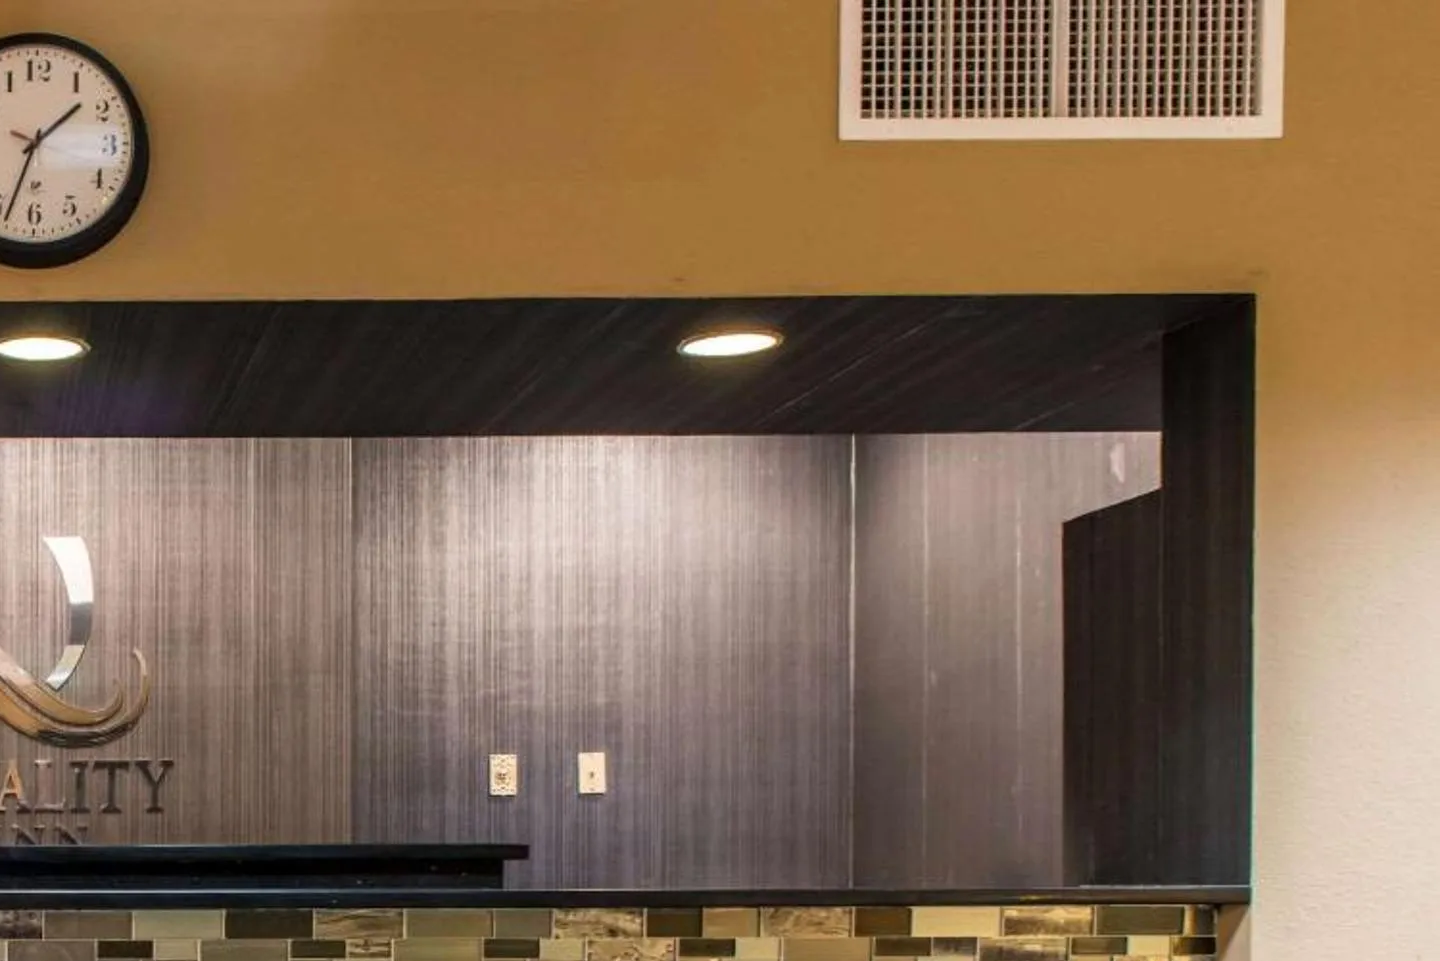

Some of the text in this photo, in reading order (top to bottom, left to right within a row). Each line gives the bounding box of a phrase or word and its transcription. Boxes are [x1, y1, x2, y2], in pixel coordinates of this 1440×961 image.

[26, 59, 51, 82] 12
[73, 71, 79, 93] 1
[96, 100, 109, 122] 2
[102, 134, 117, 155] 3
[90, 168, 103, 189] 4
[27, 201, 42, 226] 6
[62, 194, 77, 217] 5
